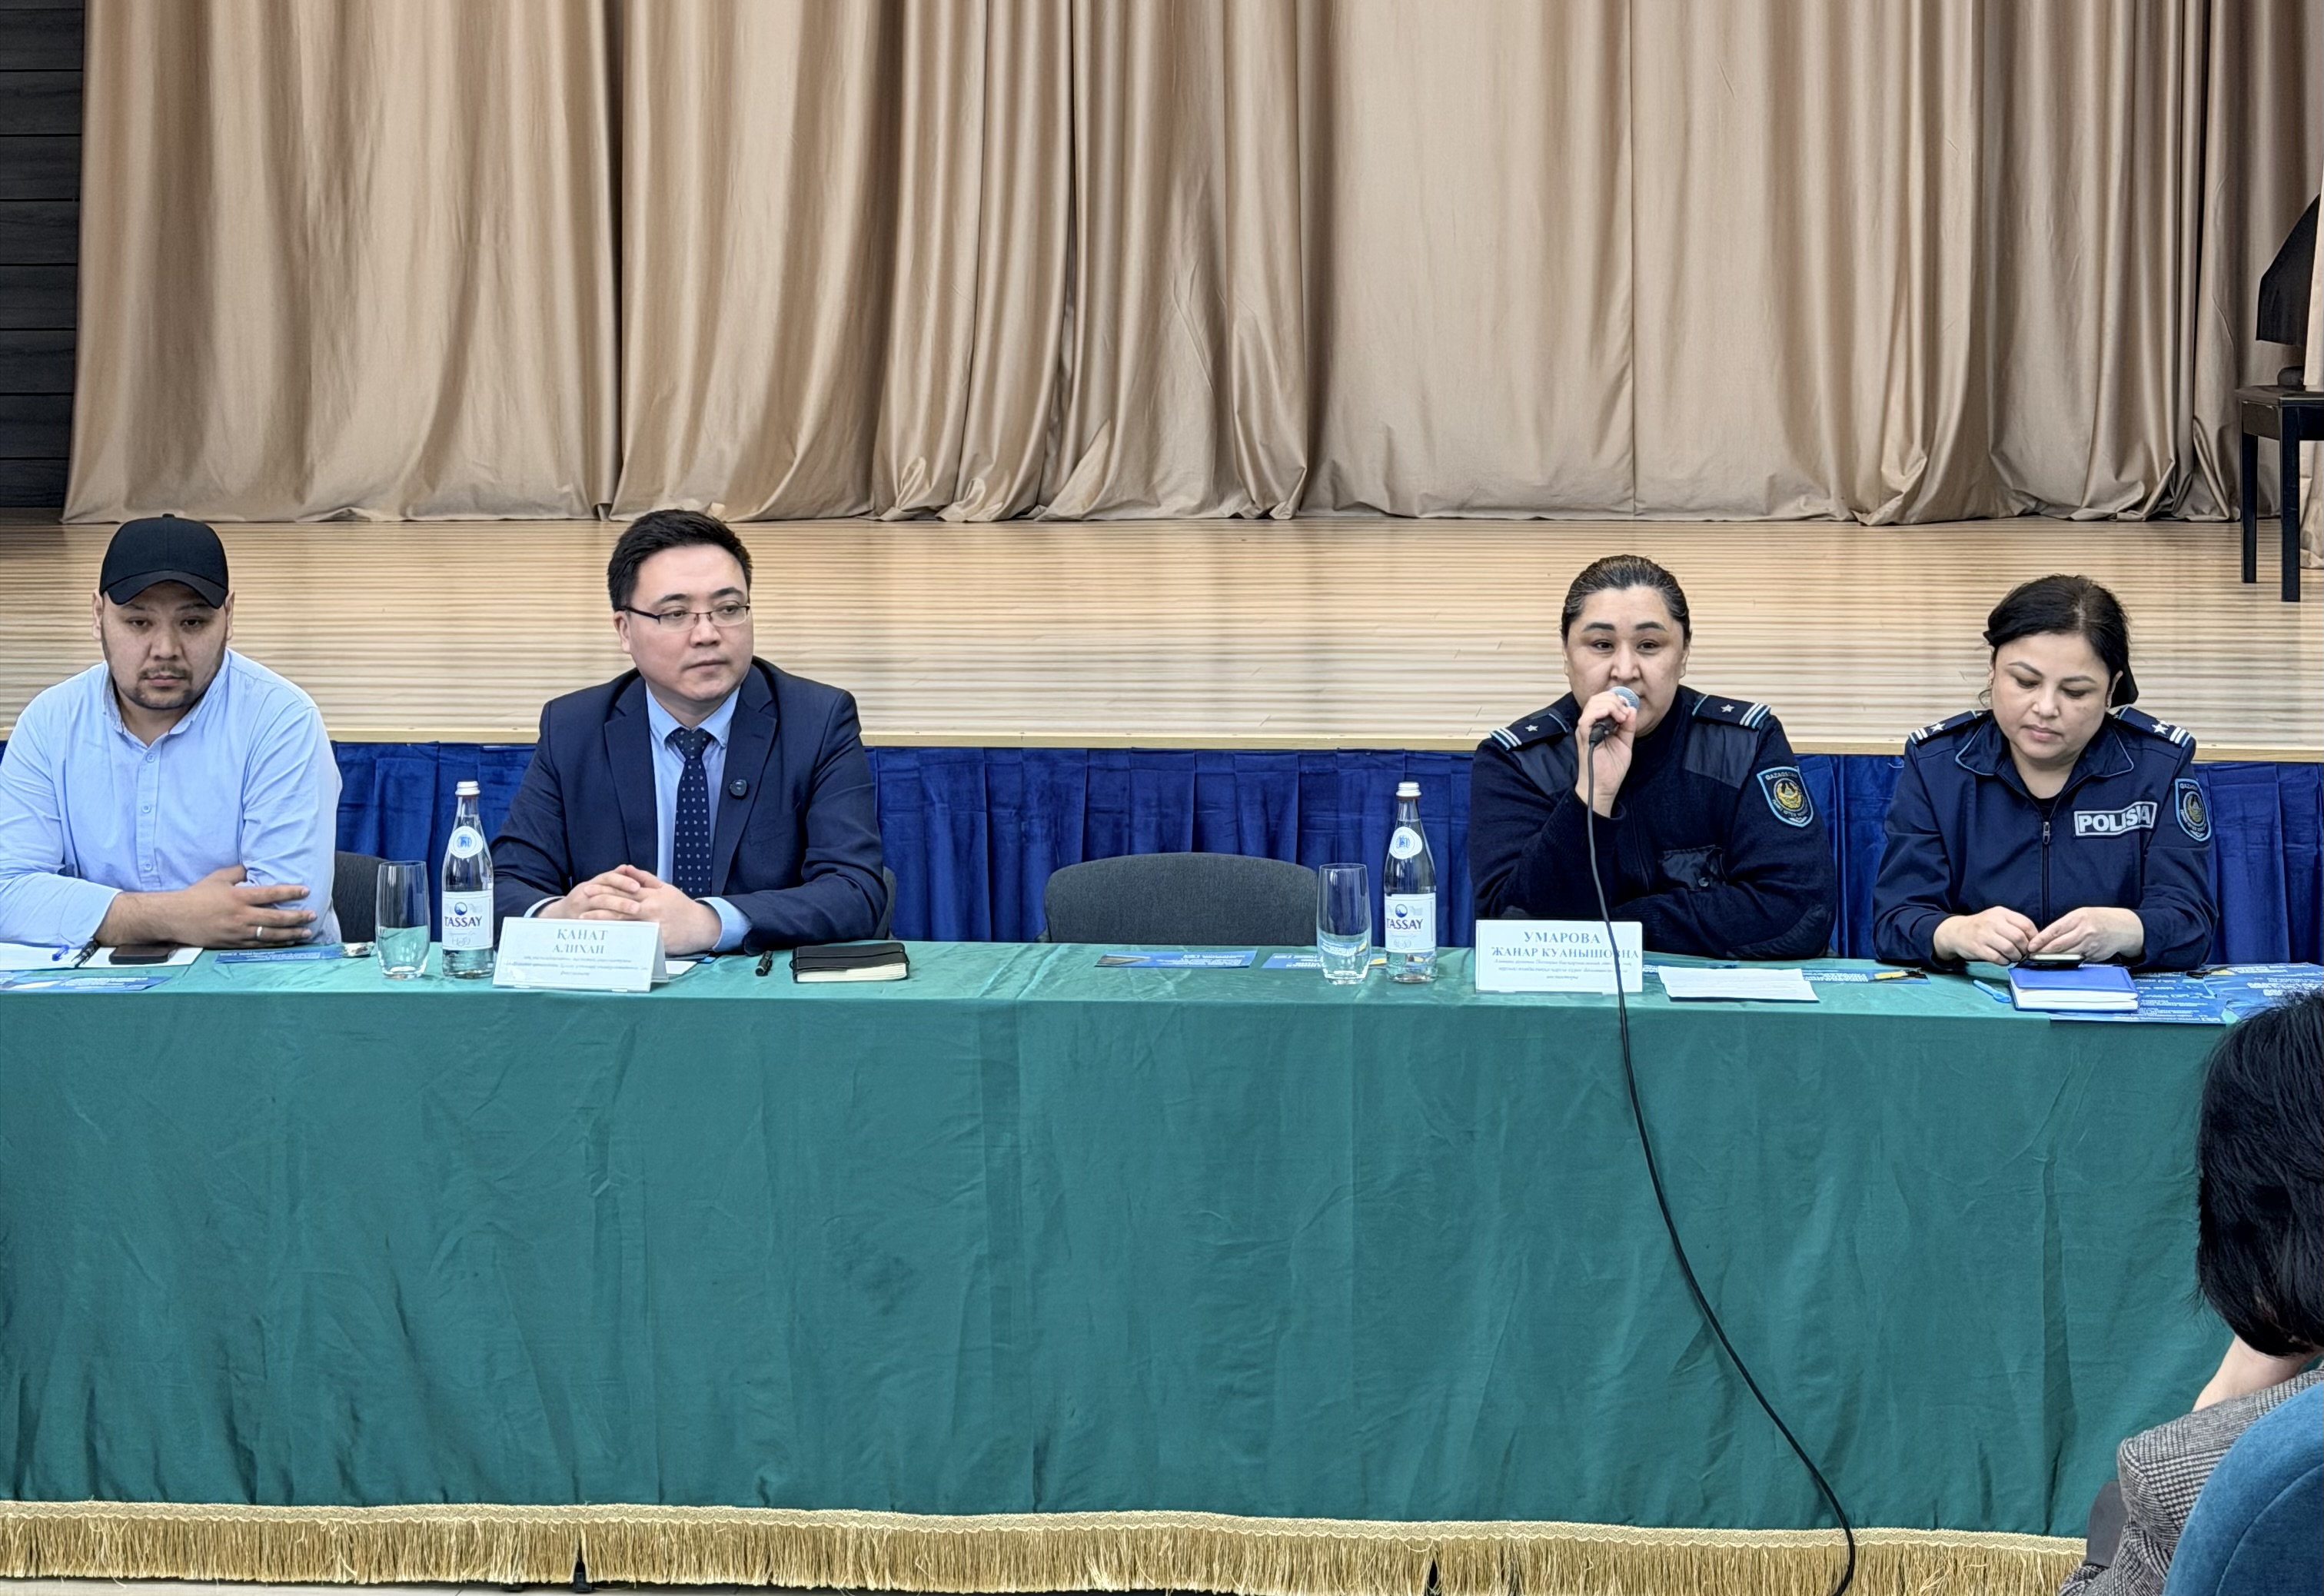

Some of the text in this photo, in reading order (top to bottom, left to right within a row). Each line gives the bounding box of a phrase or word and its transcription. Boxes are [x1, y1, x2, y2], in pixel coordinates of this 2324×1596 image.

[444, 916, 483, 927] TASSAY
[1386, 918, 1424, 929] TASSAY
[1524, 931, 1601, 944] УМАРОВА
[1491, 946, 1538, 957] ЖАНАР
